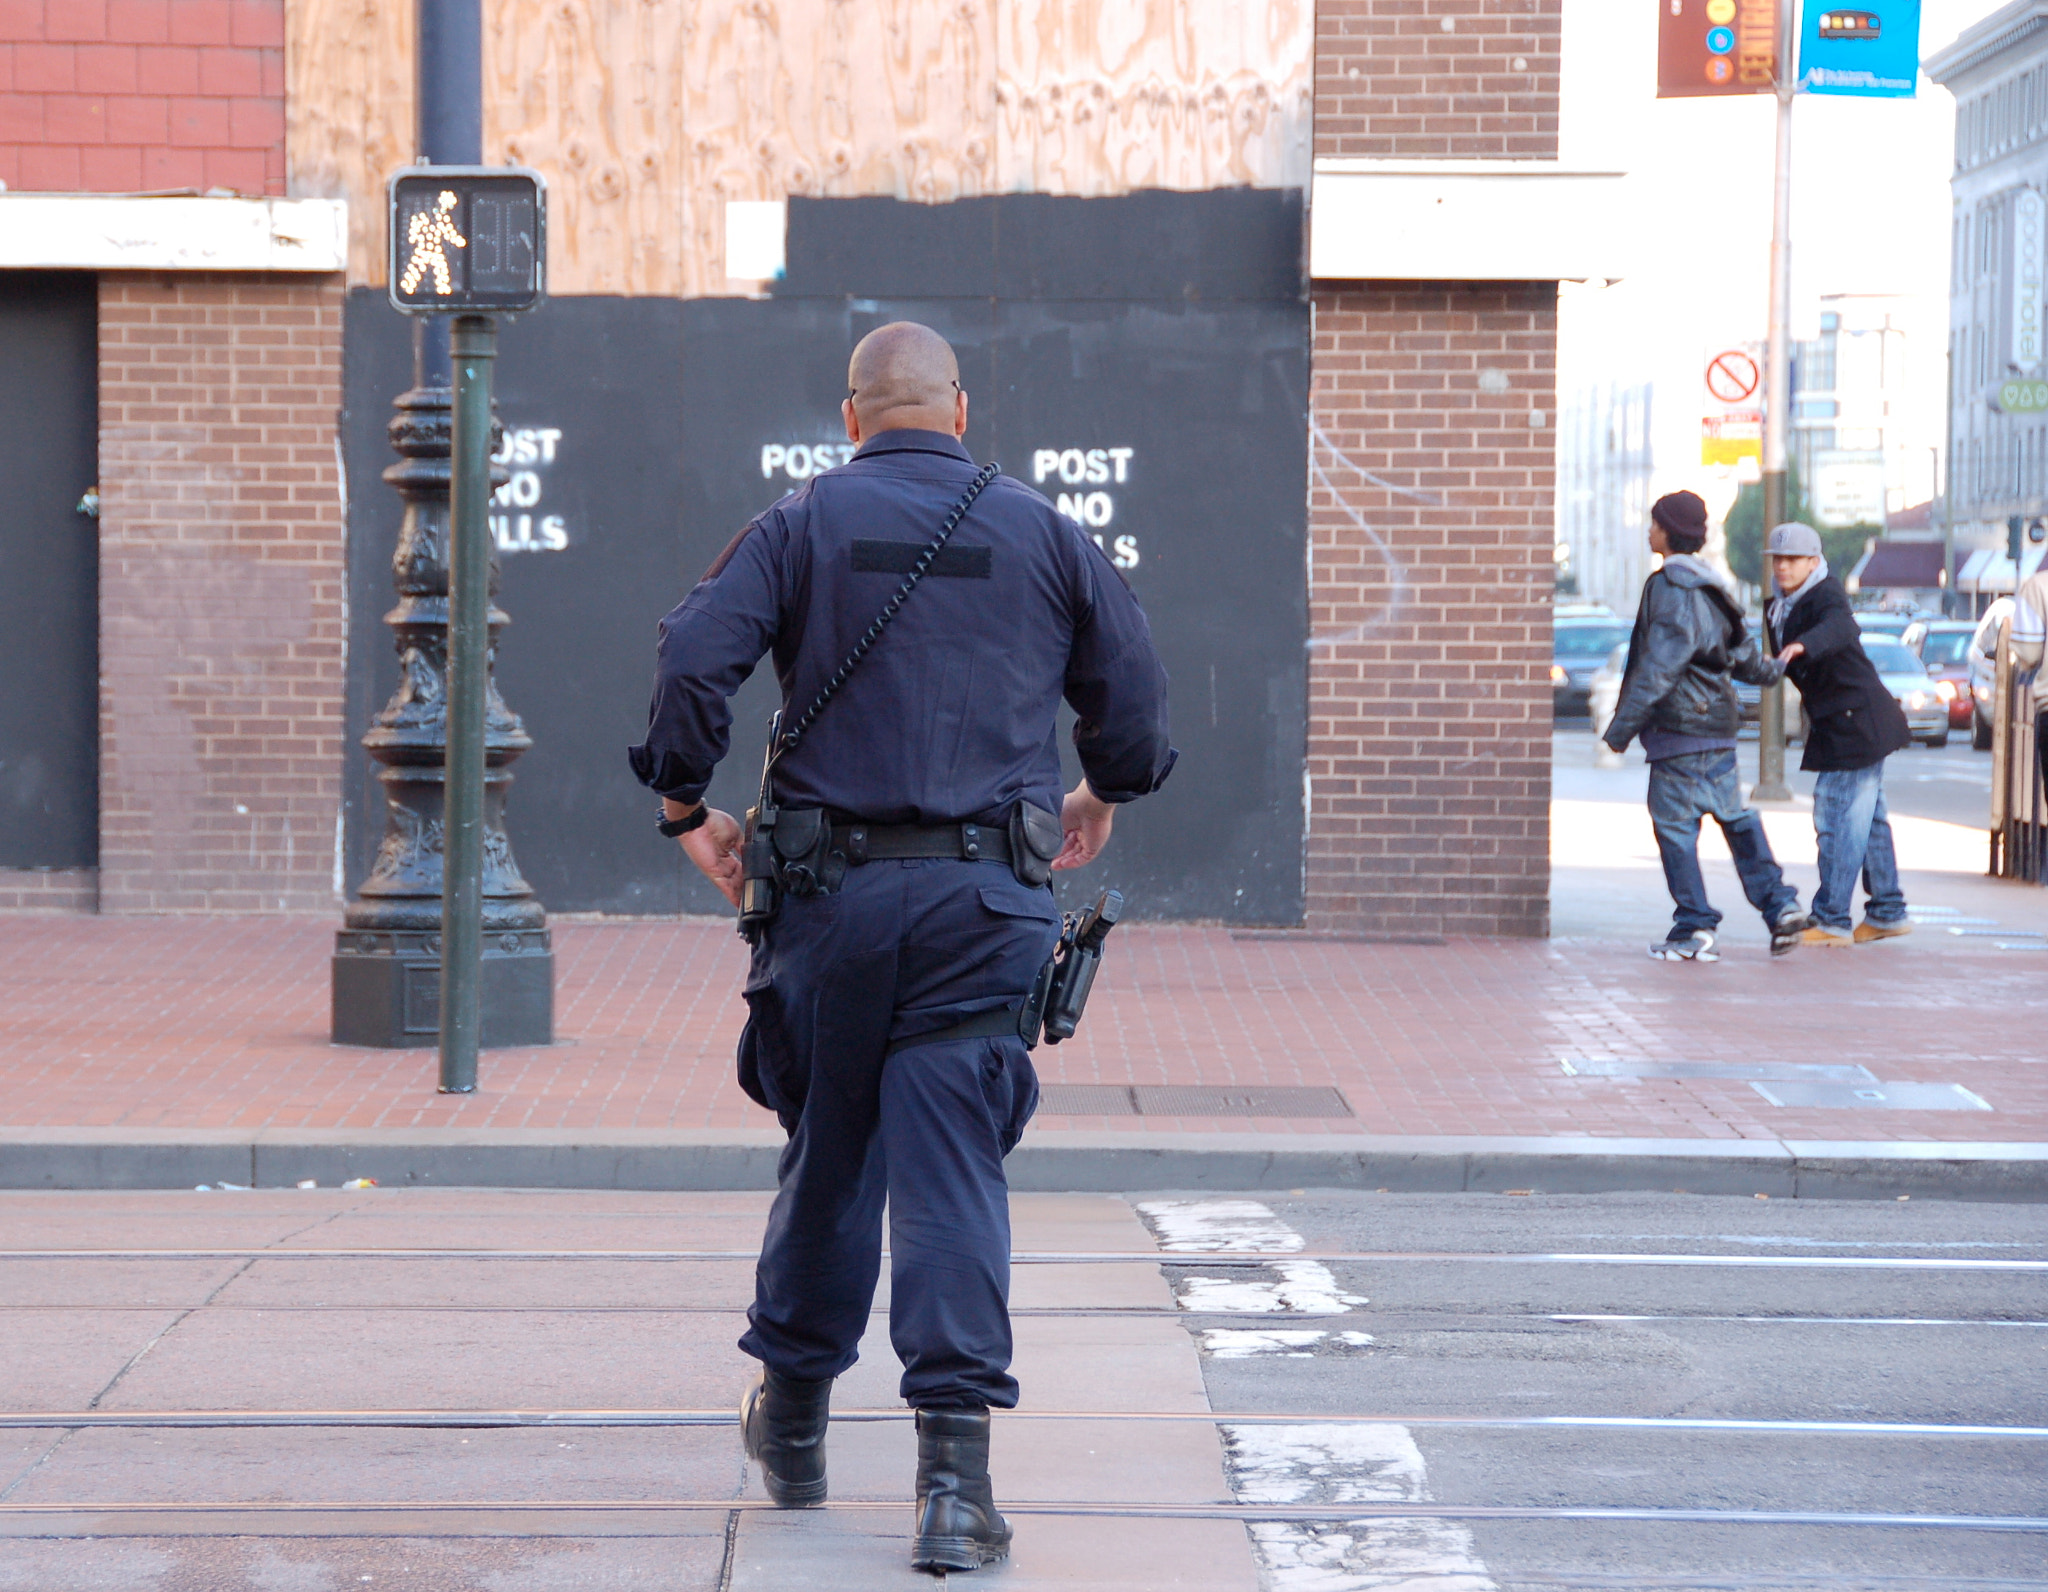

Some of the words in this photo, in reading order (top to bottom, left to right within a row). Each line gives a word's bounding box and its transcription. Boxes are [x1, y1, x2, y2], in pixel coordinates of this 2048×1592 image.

[489, 428, 562, 465] OST
[761, 443, 857, 479] POST
[1033, 447, 1134, 484] POST
[1056, 491, 1113, 528] NO
[488, 514, 569, 551] LLS
